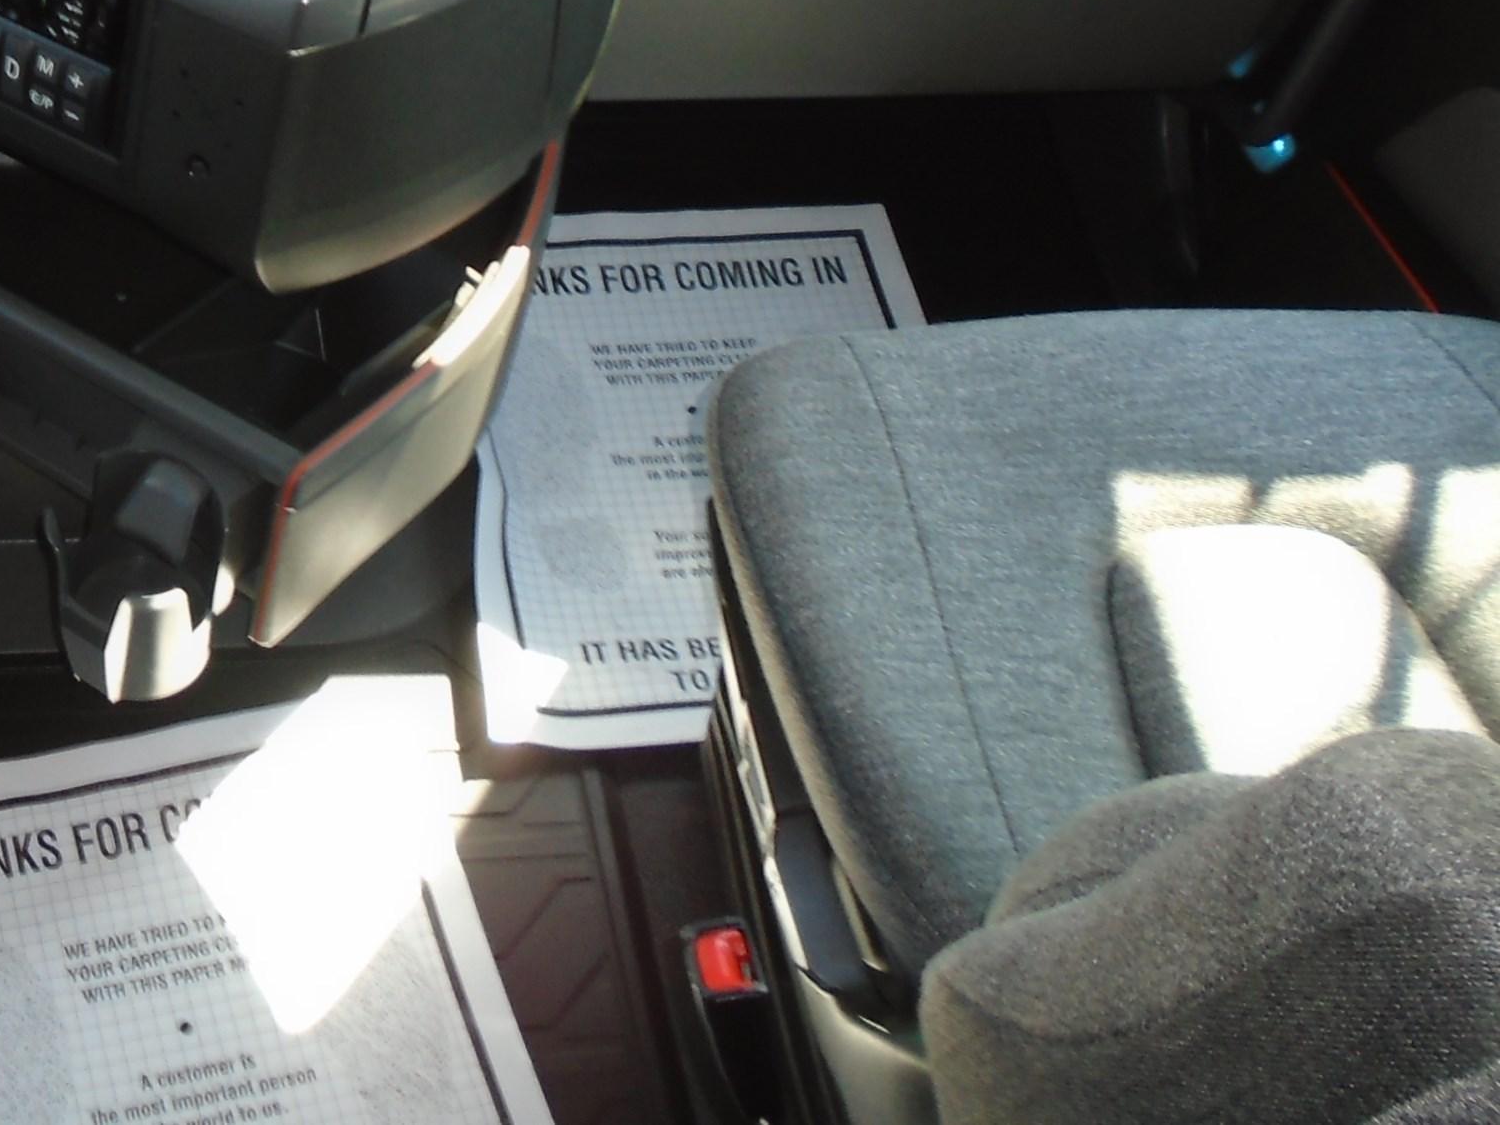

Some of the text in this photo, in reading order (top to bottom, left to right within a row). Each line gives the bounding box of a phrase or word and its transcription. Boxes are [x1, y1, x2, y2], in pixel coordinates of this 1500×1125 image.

[4, 55, 20, 80] D
[37, 54, 54, 77] M
[532, 256, 848, 295] NKS FOR COMING IN
[617, 342, 651, 355] HAVE
[700, 339, 719, 352] TO
[638, 355, 715, 369] CARPETING
[606, 373, 644, 386] WITH
[579, 636, 722, 665] IT HAS BE
[672, 670, 712, 693] TO
[72, 812, 152, 865] FOR
[64, 942, 91, 961] WE
[94, 932, 138, 955] HAVE
[140, 921, 190, 945] TRIED
[192, 915, 214, 933] TO
[67, 962, 115, 984] YOUR
[118, 940, 212, 976] CARPETING
[82, 982, 127, 1005] WITH
[130, 973, 169, 997] THIS
[170, 961, 227, 987] PAPER
[140, 1053, 257, 1092] A customer is
[90, 1066, 318, 1125] the most important person
